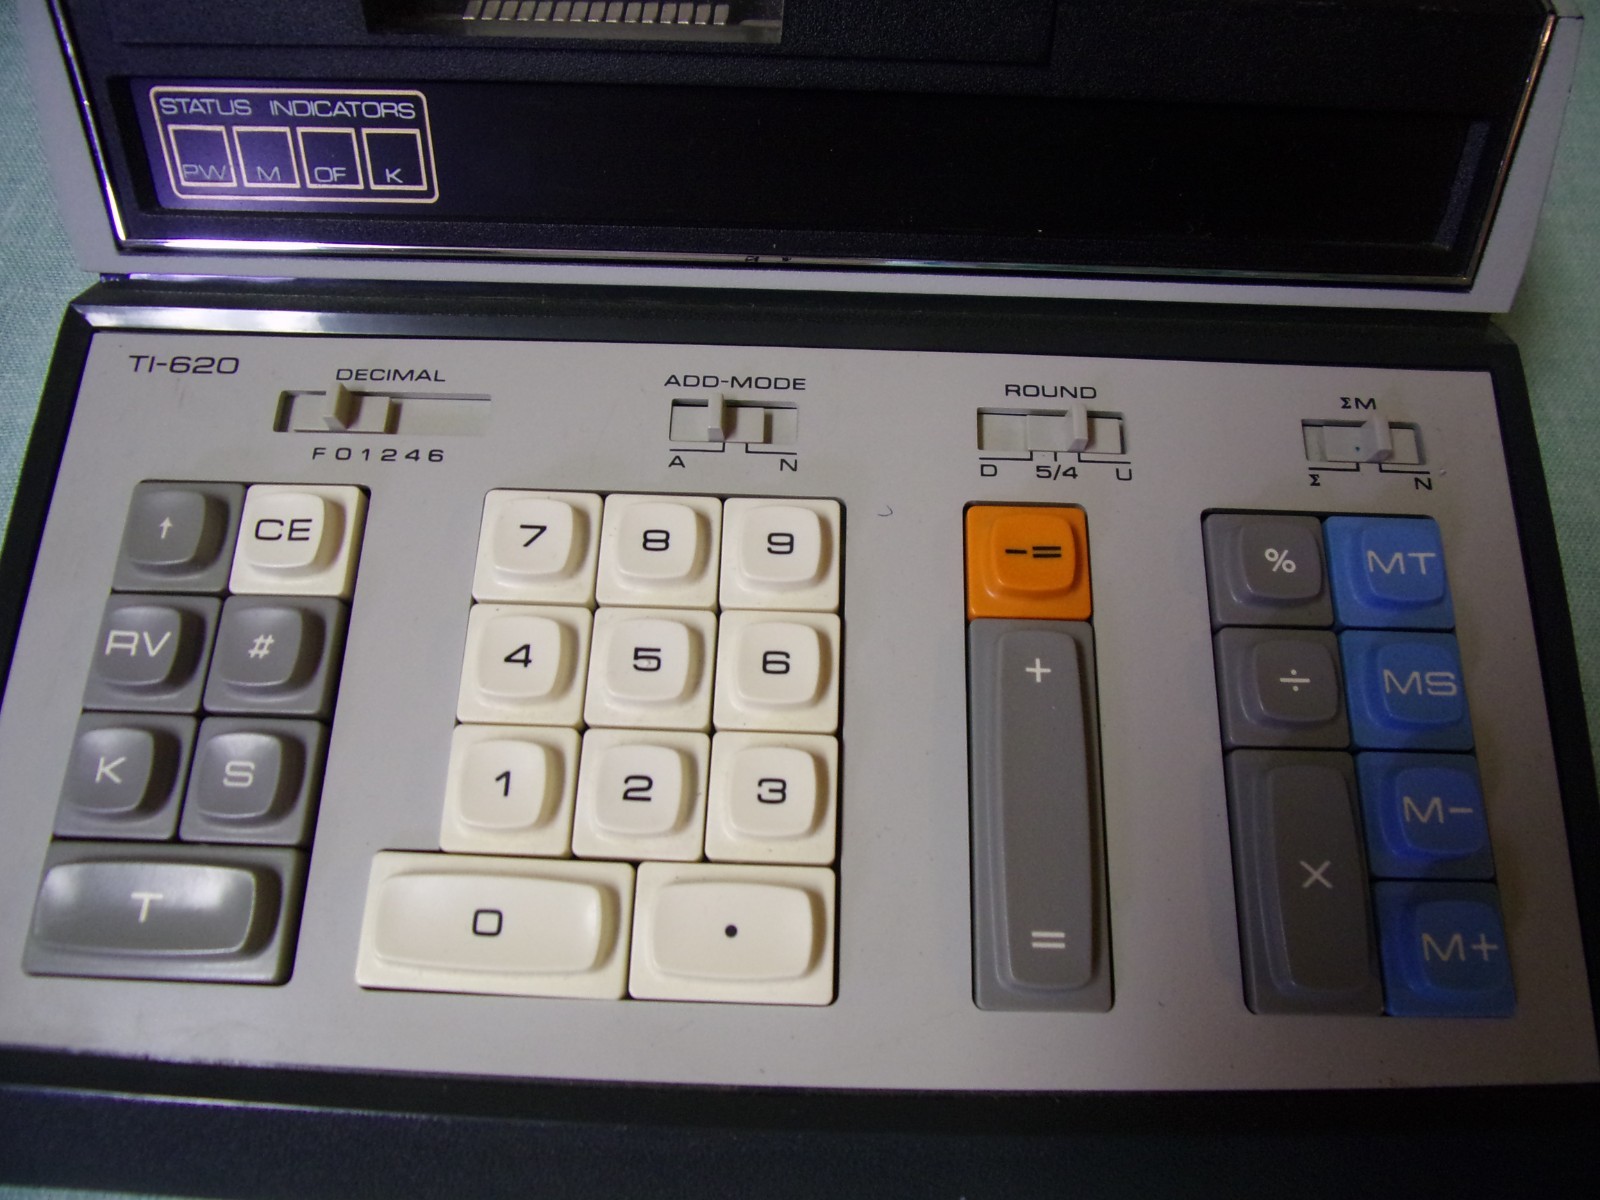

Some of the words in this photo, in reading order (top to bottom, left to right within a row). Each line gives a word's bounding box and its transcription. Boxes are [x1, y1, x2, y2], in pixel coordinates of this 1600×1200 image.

[160, 98, 252, 116] STATUS
[270, 99, 416, 120] INDICATORS
[182, 164, 227, 181] PW
[257, 165, 281, 182] M
[314, 166, 347, 183] OF
[386, 168, 403, 184] K
[129, 355, 240, 375] TI-620
[335, 368, 446, 383] DECIMAL
[664, 374, 806, 391] ADD-MODE
[1005, 384, 1097, 399] ROUND
[668, 455, 686, 469] A
[779, 458, 798, 472] N
[980, 464, 998, 477] D
[1036, 464, 1078, 481] 5/4
[1116, 467, 1133, 481] U
[1414, 477, 1433, 491] N
[254, 518, 313, 541] CE
[519, 524, 548, 548] 7
[642, 529, 671, 552] 8
[766, 532, 795, 555] 9
[1264, 548, 1297, 574] %
[1366, 549, 1436, 575] MT
[248, 633, 275, 659] #
[503, 643, 533, 668] 4
[633, 647, 662, 672] 5
[762, 650, 791, 674] 6
[1382, 668, 1458, 696] MS
[94, 756, 127, 784] K
[222, 760, 255, 788] S
[494, 770, 512, 798] 1
[622, 775, 654, 802] 2
[756, 777, 787, 805] 3
[1402, 795, 1473, 824] M-
[130, 891, 164, 923] T
[1421, 932, 1499, 962] M+
